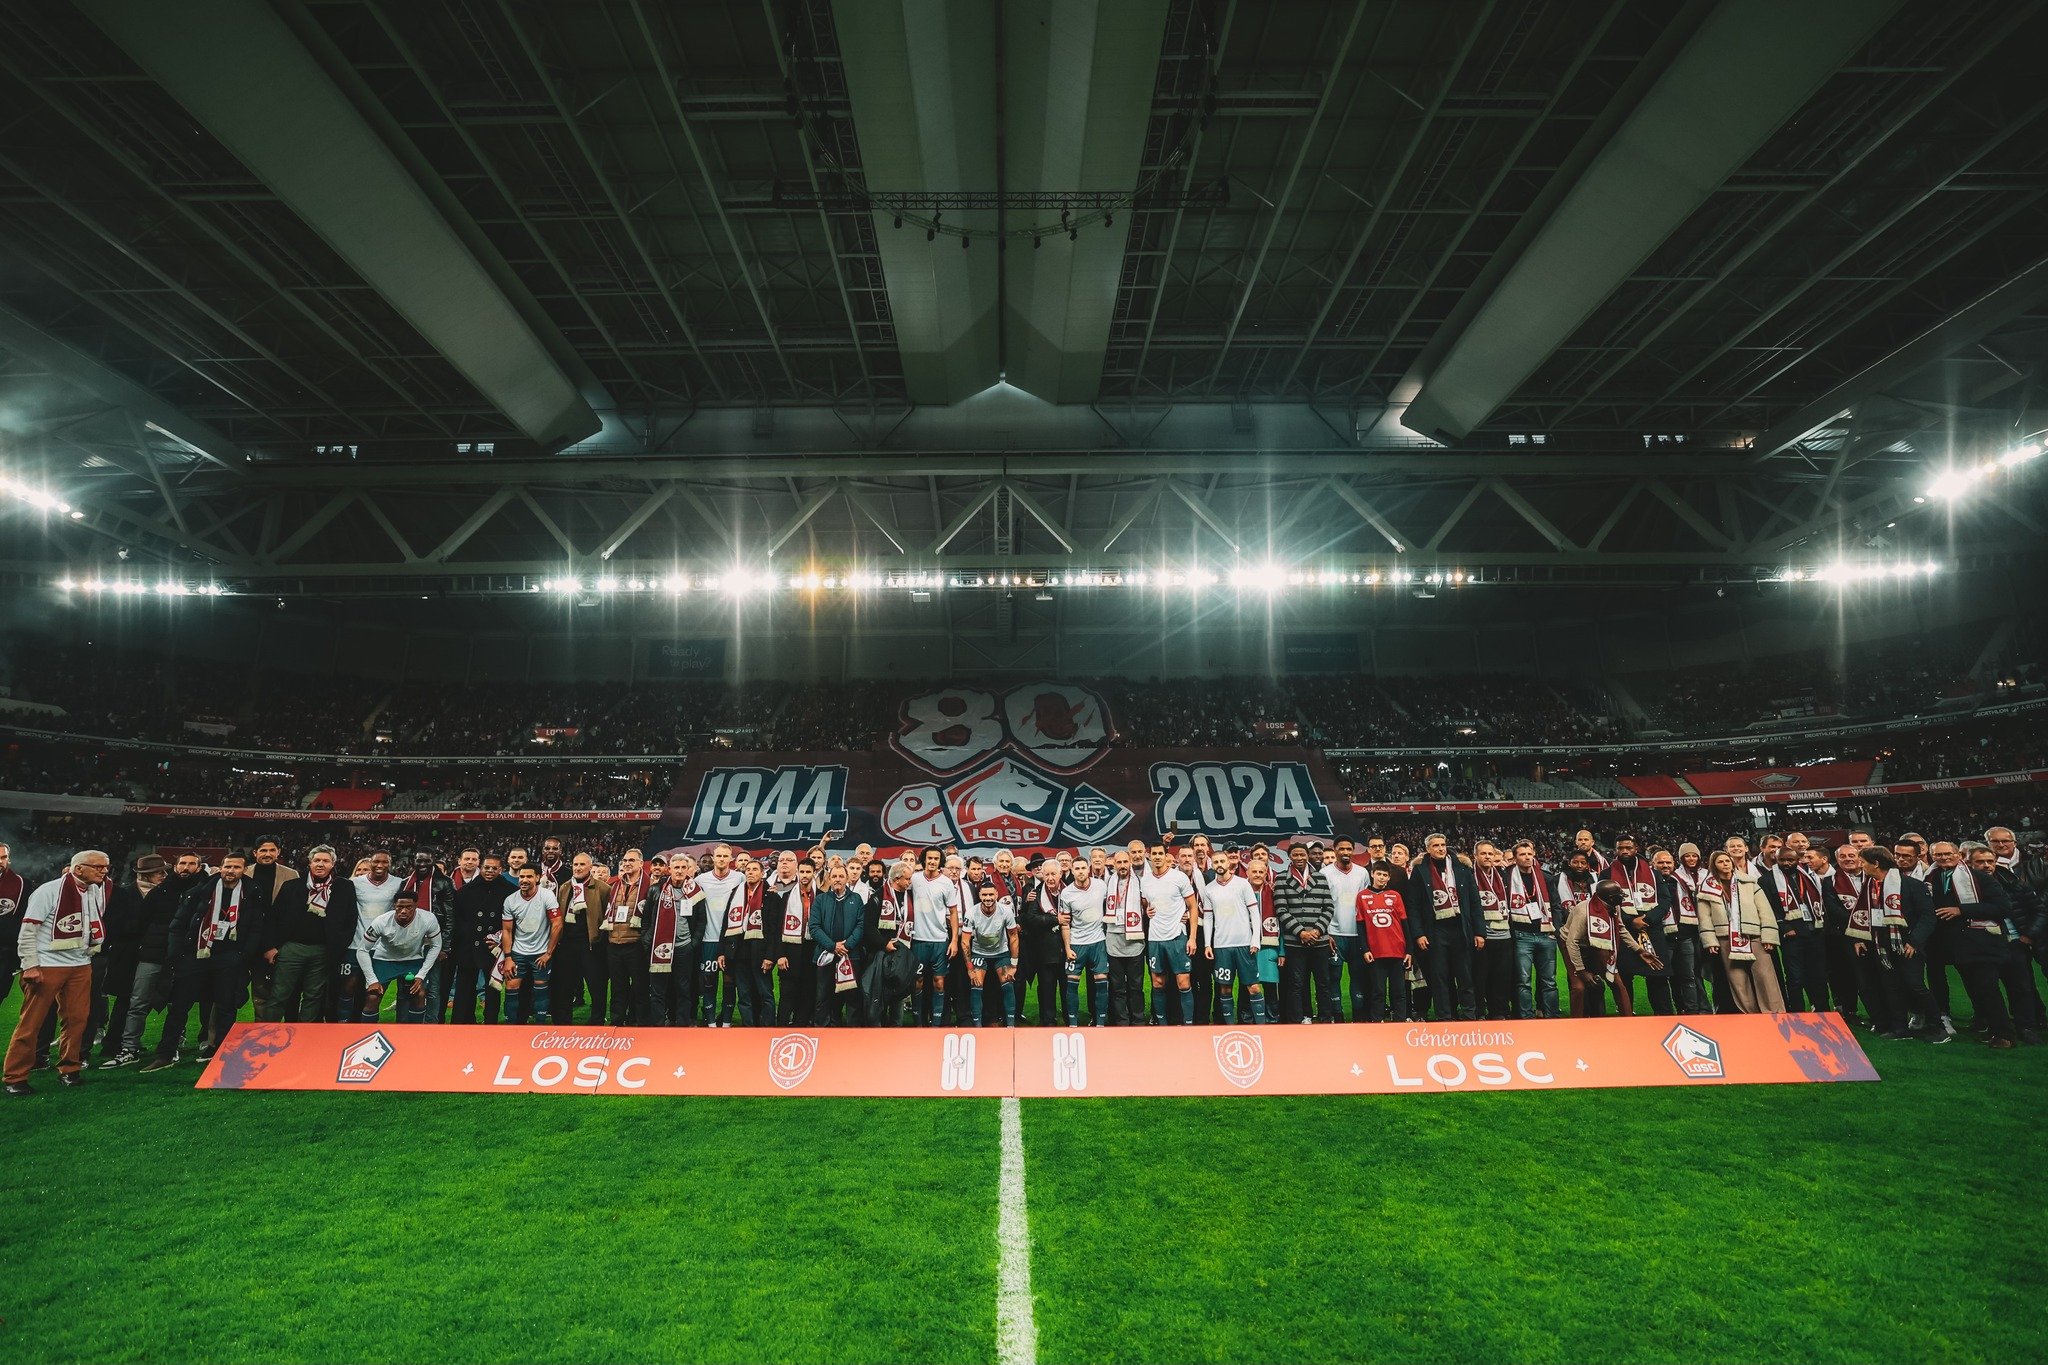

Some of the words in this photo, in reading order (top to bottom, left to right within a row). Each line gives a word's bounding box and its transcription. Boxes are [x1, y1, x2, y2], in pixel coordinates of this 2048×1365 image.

[662, 645, 700, 658] Ready
[681, 657, 711, 671] play?
[898, 684, 1107, 770] 80
[1994, 773, 2033, 784] WINAMAX
[1851, 787, 1889, 796] WINAMAX
[1922, 781, 1960, 791] WINAMAX
[1156, 766, 1314, 829] 2024
[1671, 798, 1701, 806] WINAMAX
[1733, 795, 1767, 803] WINAMAX
[1789, 792, 1825, 800] WINAMAX
[694, 770, 834, 835] 1944
[1612, 800, 1638, 808] WINAMAX
[971, 828, 1041, 841] LOSC
[340, 963, 352, 975] 18
[705, 960, 718, 972] 20
[1218, 967, 1231, 981] 23
[531, 1031, 635, 1051] Générations
[1405, 1028, 1515, 1047] Générations
[343, 1069, 371, 1078] LOSC
[493, 1055, 652, 1089] LOSC
[1386, 1051, 1555, 1087] LOSC
[1685, 1063, 1717, 1073] LOSC
